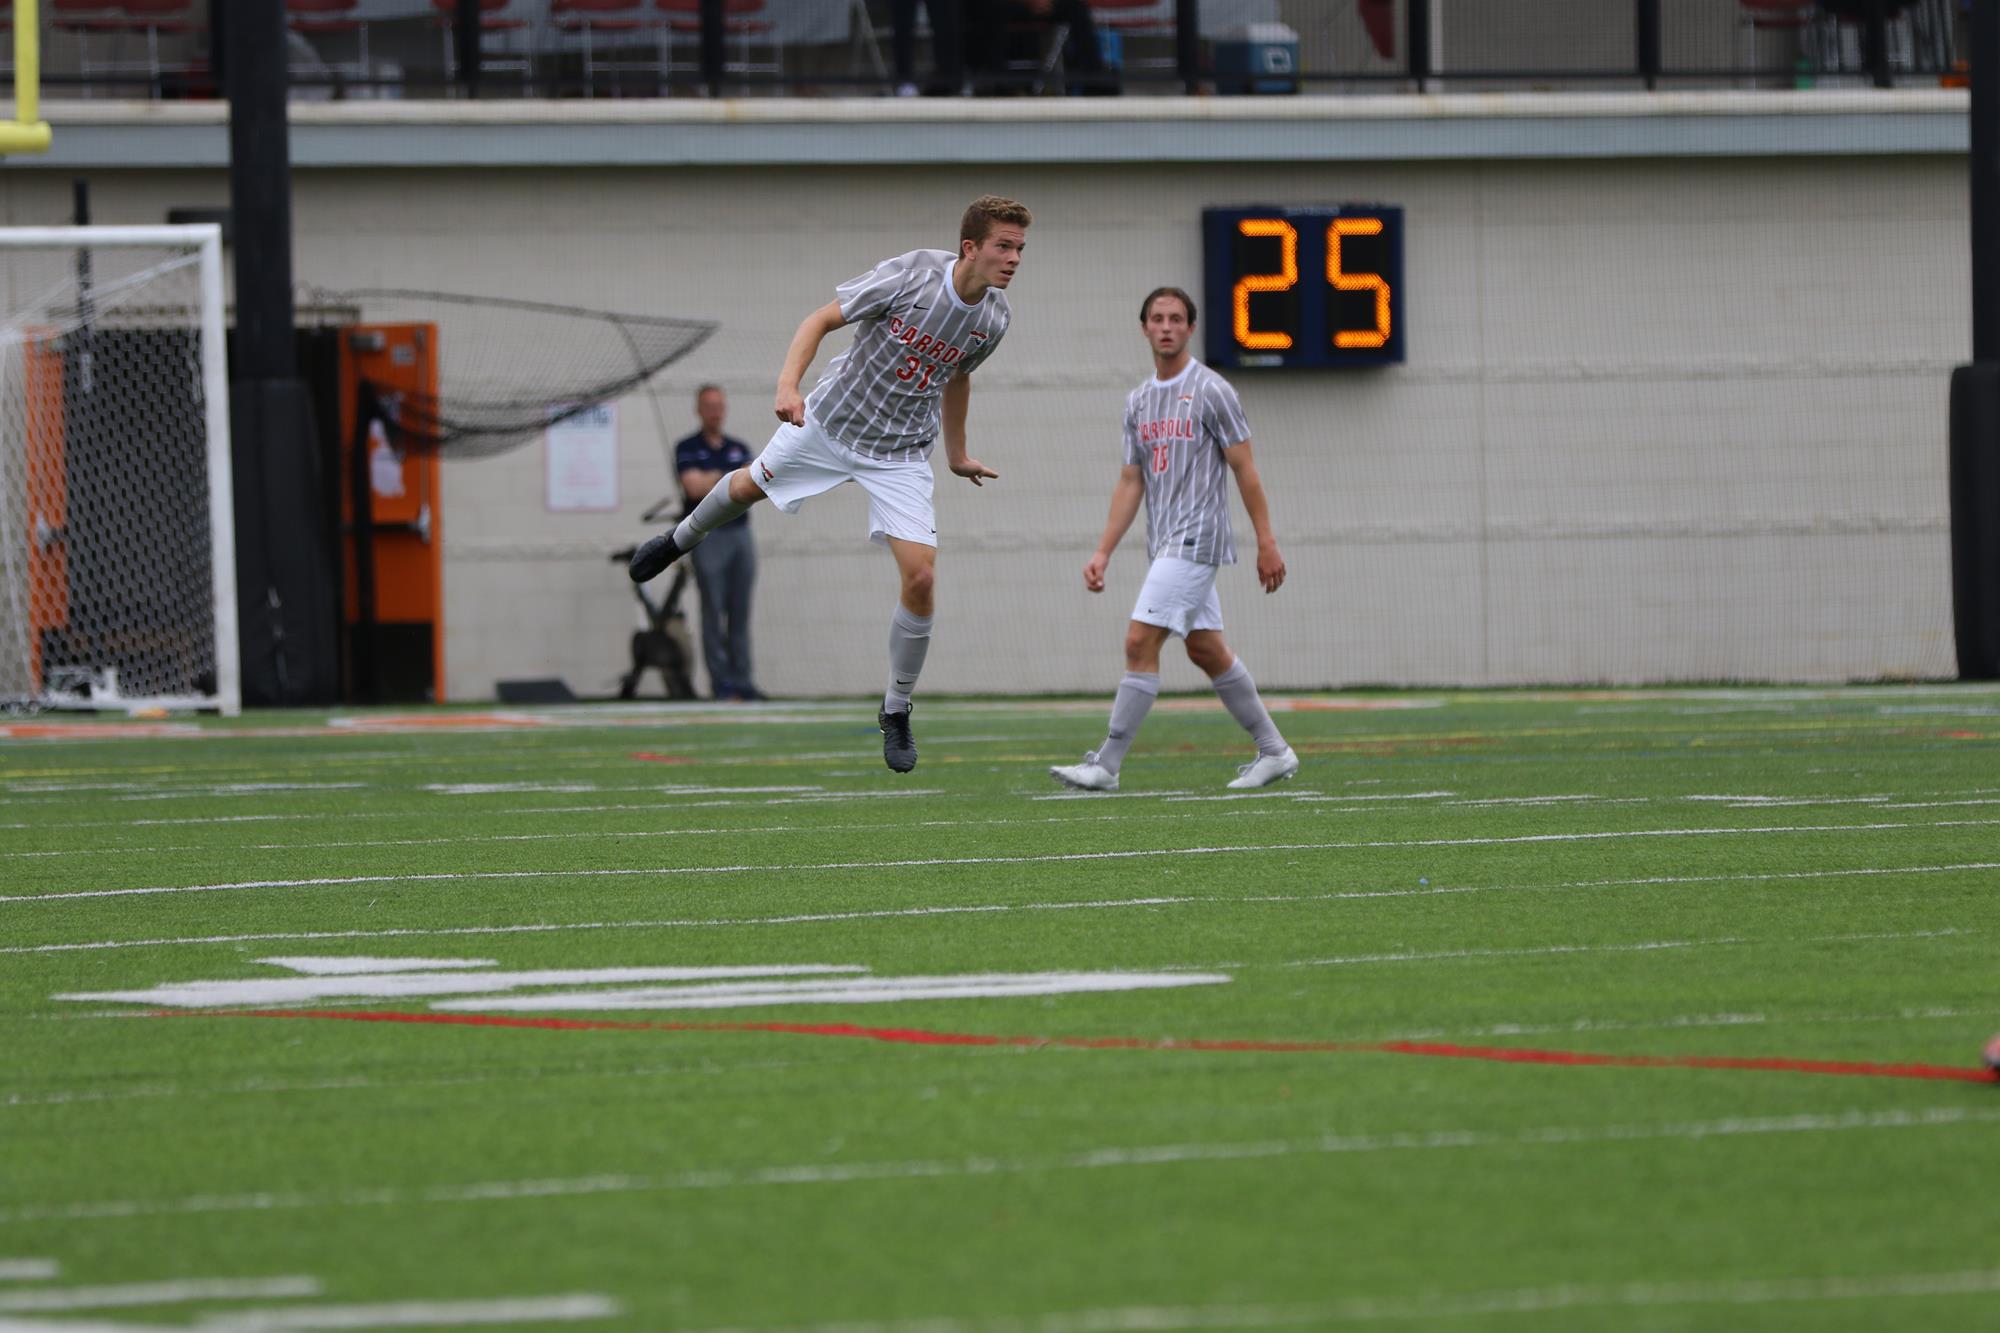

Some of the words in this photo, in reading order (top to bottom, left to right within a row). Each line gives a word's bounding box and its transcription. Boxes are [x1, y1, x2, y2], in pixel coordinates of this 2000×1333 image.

[1233, 217, 1391, 349] 25
[889, 315, 968, 367] CARROL
[895, 354, 937, 391] 31
